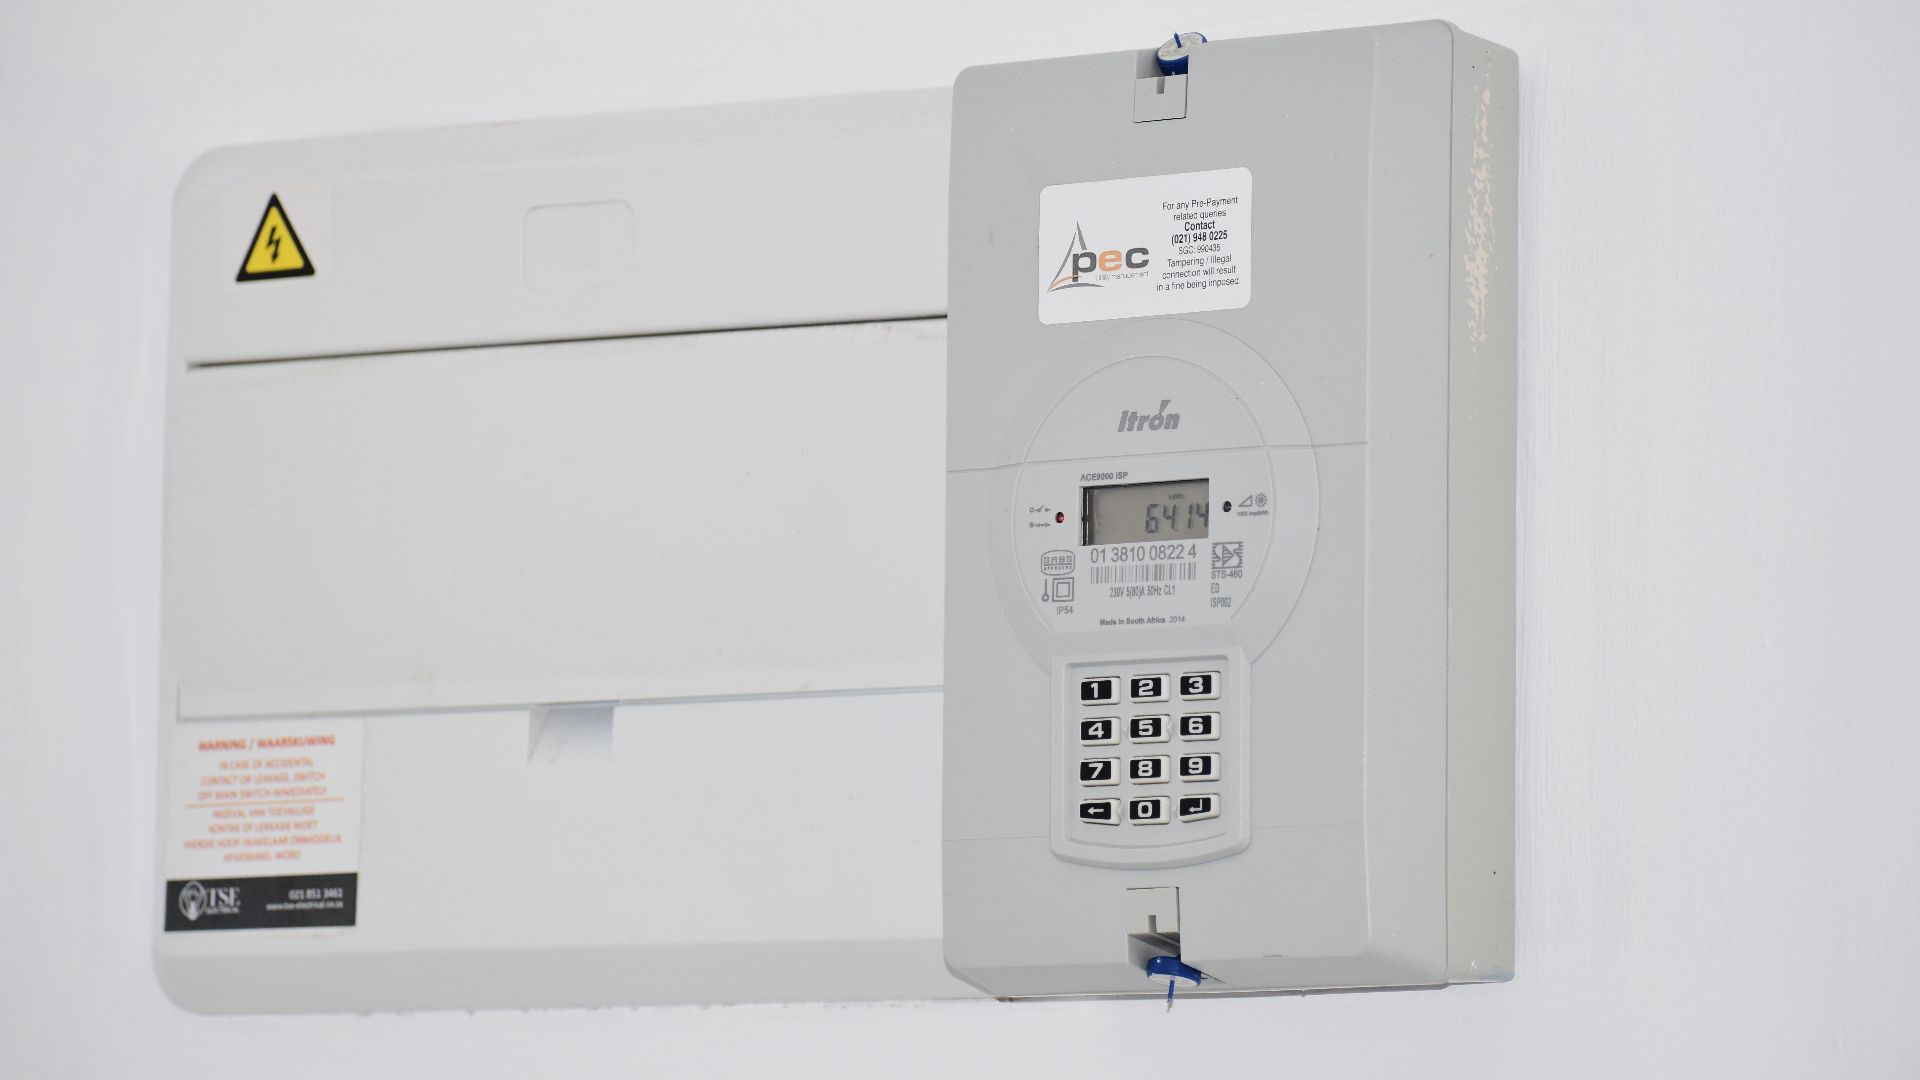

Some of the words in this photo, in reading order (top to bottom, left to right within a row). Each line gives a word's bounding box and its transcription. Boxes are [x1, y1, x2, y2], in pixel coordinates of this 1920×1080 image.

[1162, 202, 1174, 210] For
[1176, 202, 1189, 210] any
[1192, 196, 1238, 208] Pre-Payment
[1174, 212, 1198, 221] related
[1200, 209, 1226, 220] queries
[1184, 220, 1216, 231] Contact
[1171, 233, 1191, 246] (021)
[1193, 232, 1207, 242] 948
[1209, 230, 1228, 240] 0225
[1072, 248, 1150, 282] pec
[1168, 258, 1204, 268] Tampering
[1210, 254, 1232, 264] Illegal
[1162, 268, 1200, 280] connection
[1203, 267, 1214, 276] will
[1216, 266, 1236, 274] result
[1156, 284, 1164, 292] in
[1172, 282, 1185, 290] fine
[1186, 280, 1206, 290] being
[1208, 277, 1240, 288] imposed.
[1118, 400, 1180, 432] Itron
[1080, 472, 1114, 482] ACE9000
[1116, 472, 1128, 480] ISP
[1145, 501, 1209, 534] 64.14
[1090, 548, 1106, 564] 01
[1110, 546, 1146, 562] 3810
[1149, 544, 1184, 560] 0822
[1188, 544, 1197, 558] 4
[1211, 570, 1242, 579] STS-460
[1110, 586, 1124, 598] 230V
[1126, 586, 1145, 598] 5(80)A
[1147, 585, 1162, 596] 50Hz
[1164, 584, 1176, 596] CL1
[1210, 582, 1220, 594] ED
[1210, 596, 1232, 608] ISP002
[1056, 606, 1074, 614] IP54
[1100, 618, 1116, 626] Made
[1126, 616, 1145, 624] South
[1146, 616, 1166, 624] Africa
[1090, 682, 1098, 699] 1
[1138, 680, 1154, 696] 2
[1188, 676, 1204, 694] 3
[1088, 722, 1104, 738] 4
[1138, 720, 1153, 736] 5
[1188, 718, 1204, 734] 6
[198, 738, 247, 751] WARNING
[1088, 762, 1104, 779] 7
[1138, 760, 1152, 776] 8
[1188, 758, 1203, 774] 9
[1138, 802, 1152, 818] 0
